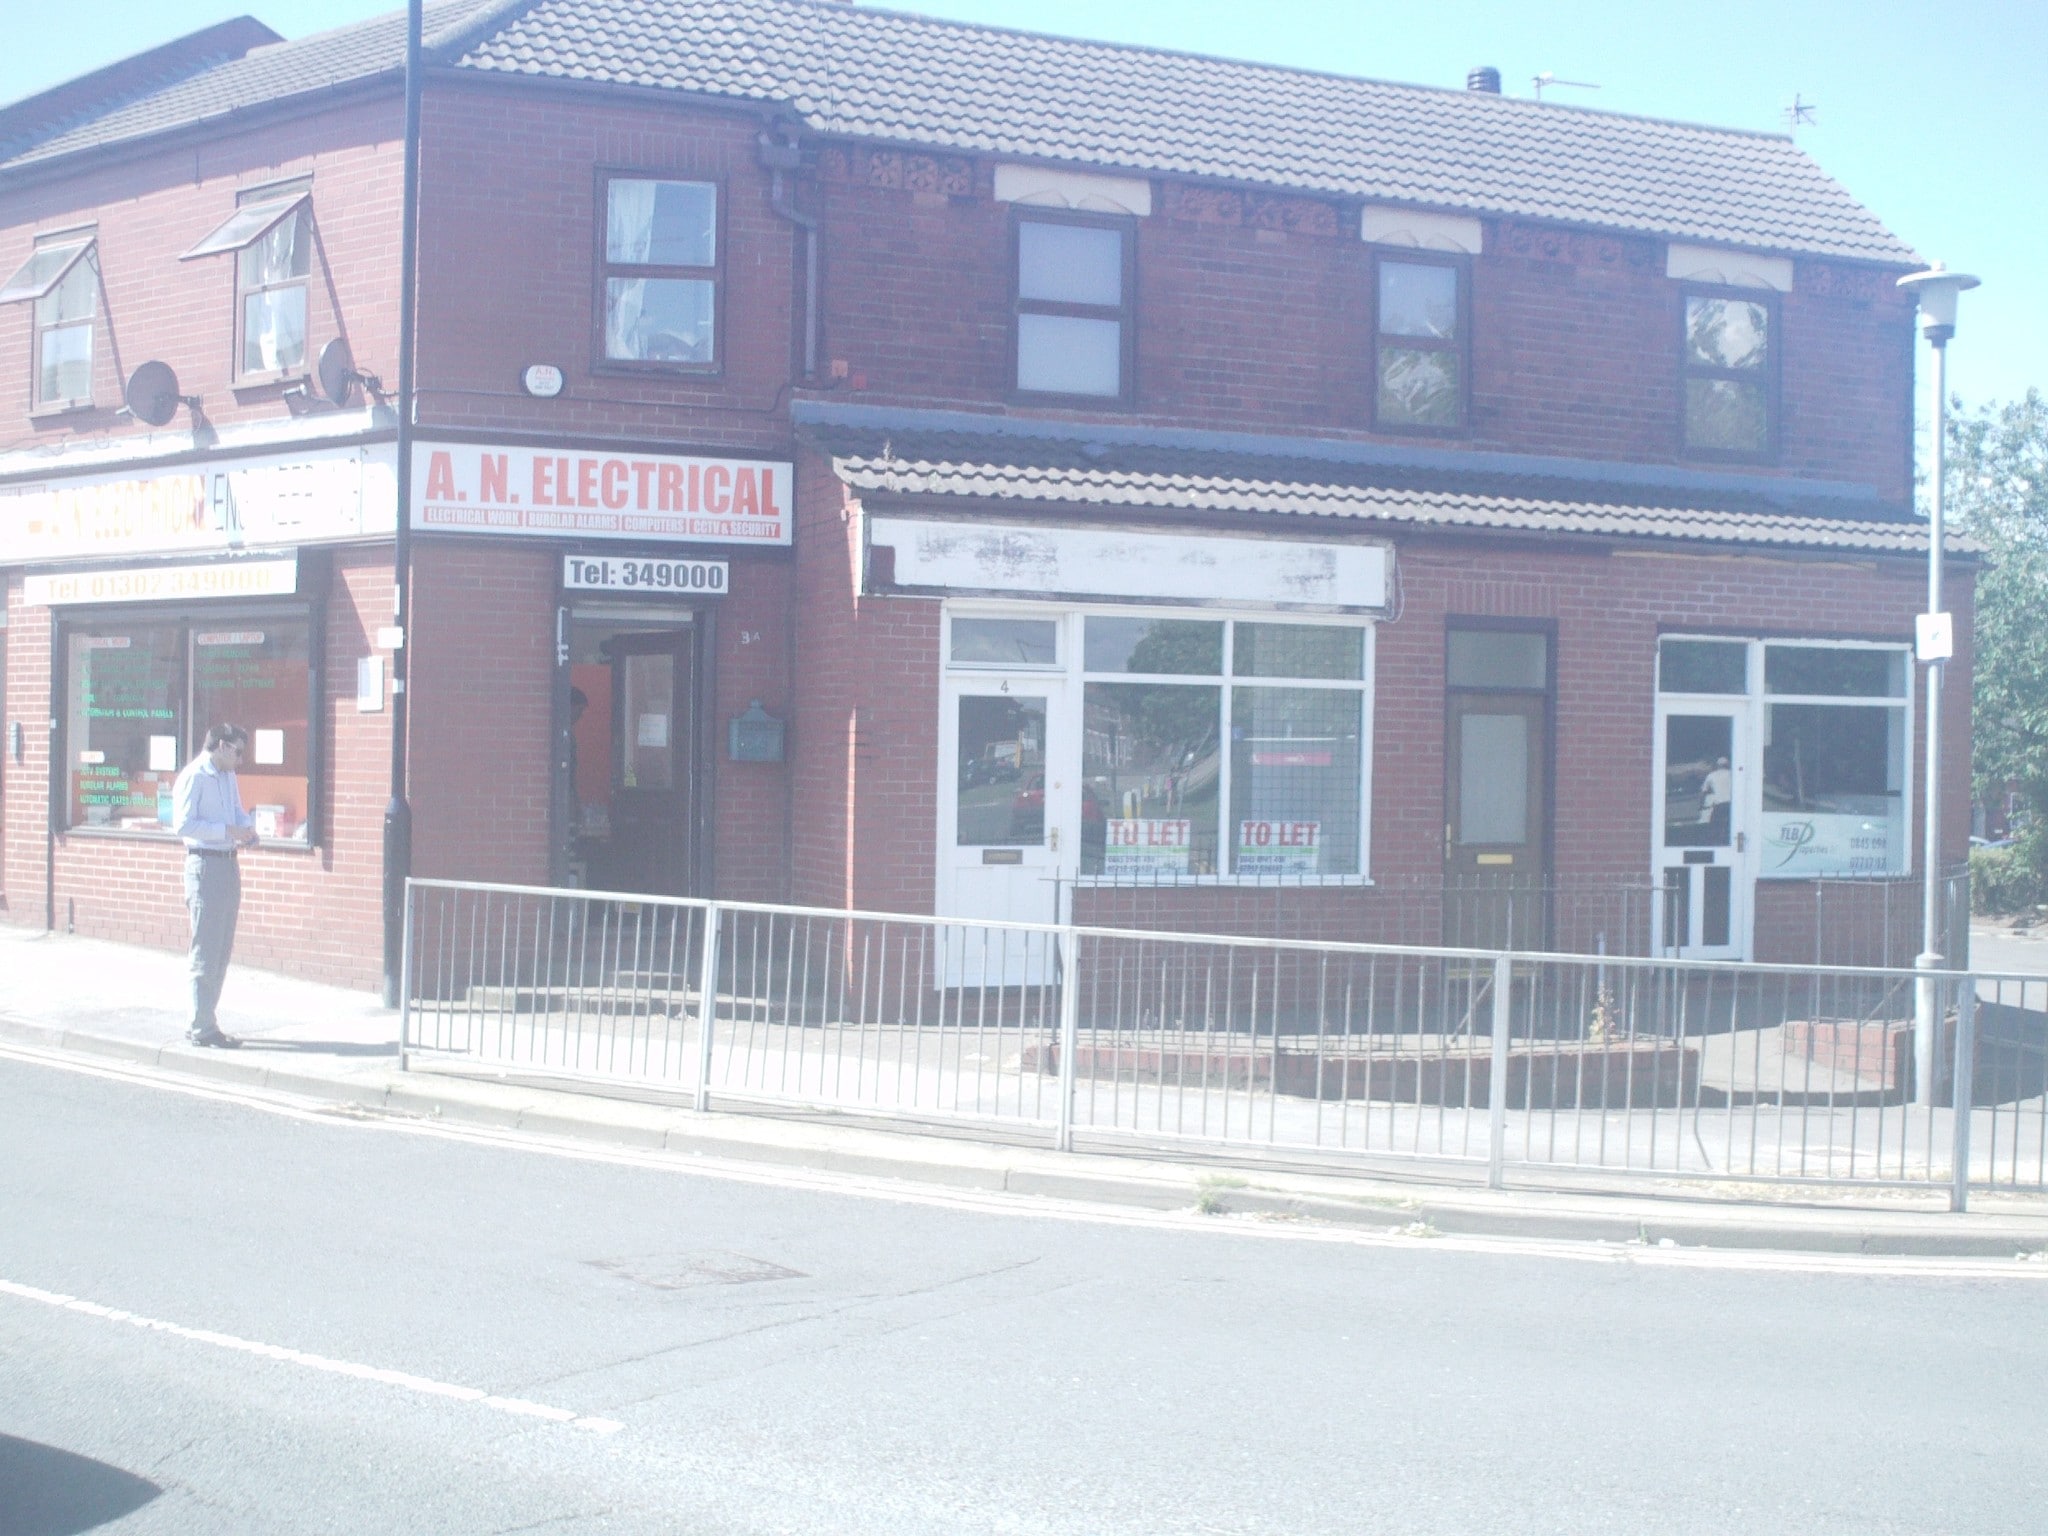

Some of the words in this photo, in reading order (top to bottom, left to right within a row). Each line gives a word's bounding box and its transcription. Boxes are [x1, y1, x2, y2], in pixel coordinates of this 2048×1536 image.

[424, 450, 467, 501] A.
[480, 453, 519, 504] N.
[533, 456, 780, 516] ELECTRICAL
[428, 507, 486, 524] ELECTRICAL
[487, 509, 519, 526] WORK
[529, 511, 575, 528] BURGLAR
[576, 513, 618, 531] ALARMS
[624, 515, 685, 533] COMPUTERS
[694, 519, 720, 535] CCTV
[721, 522, 729, 535] &
[730, 521, 777, 537] SECURITY
[91, 574, 163, 598] 01302
[171, 569, 272, 593] 349000
[570, 560, 616, 585] Tel:
[622, 562, 723, 589] 349000
[1000, 680, 1010, 693] 4
[1111, 821, 1139, 846] TO
[1148, 821, 1188, 846] LET
[1244, 822, 1272, 846] TO
[1279, 823, 1318, 846] LET
